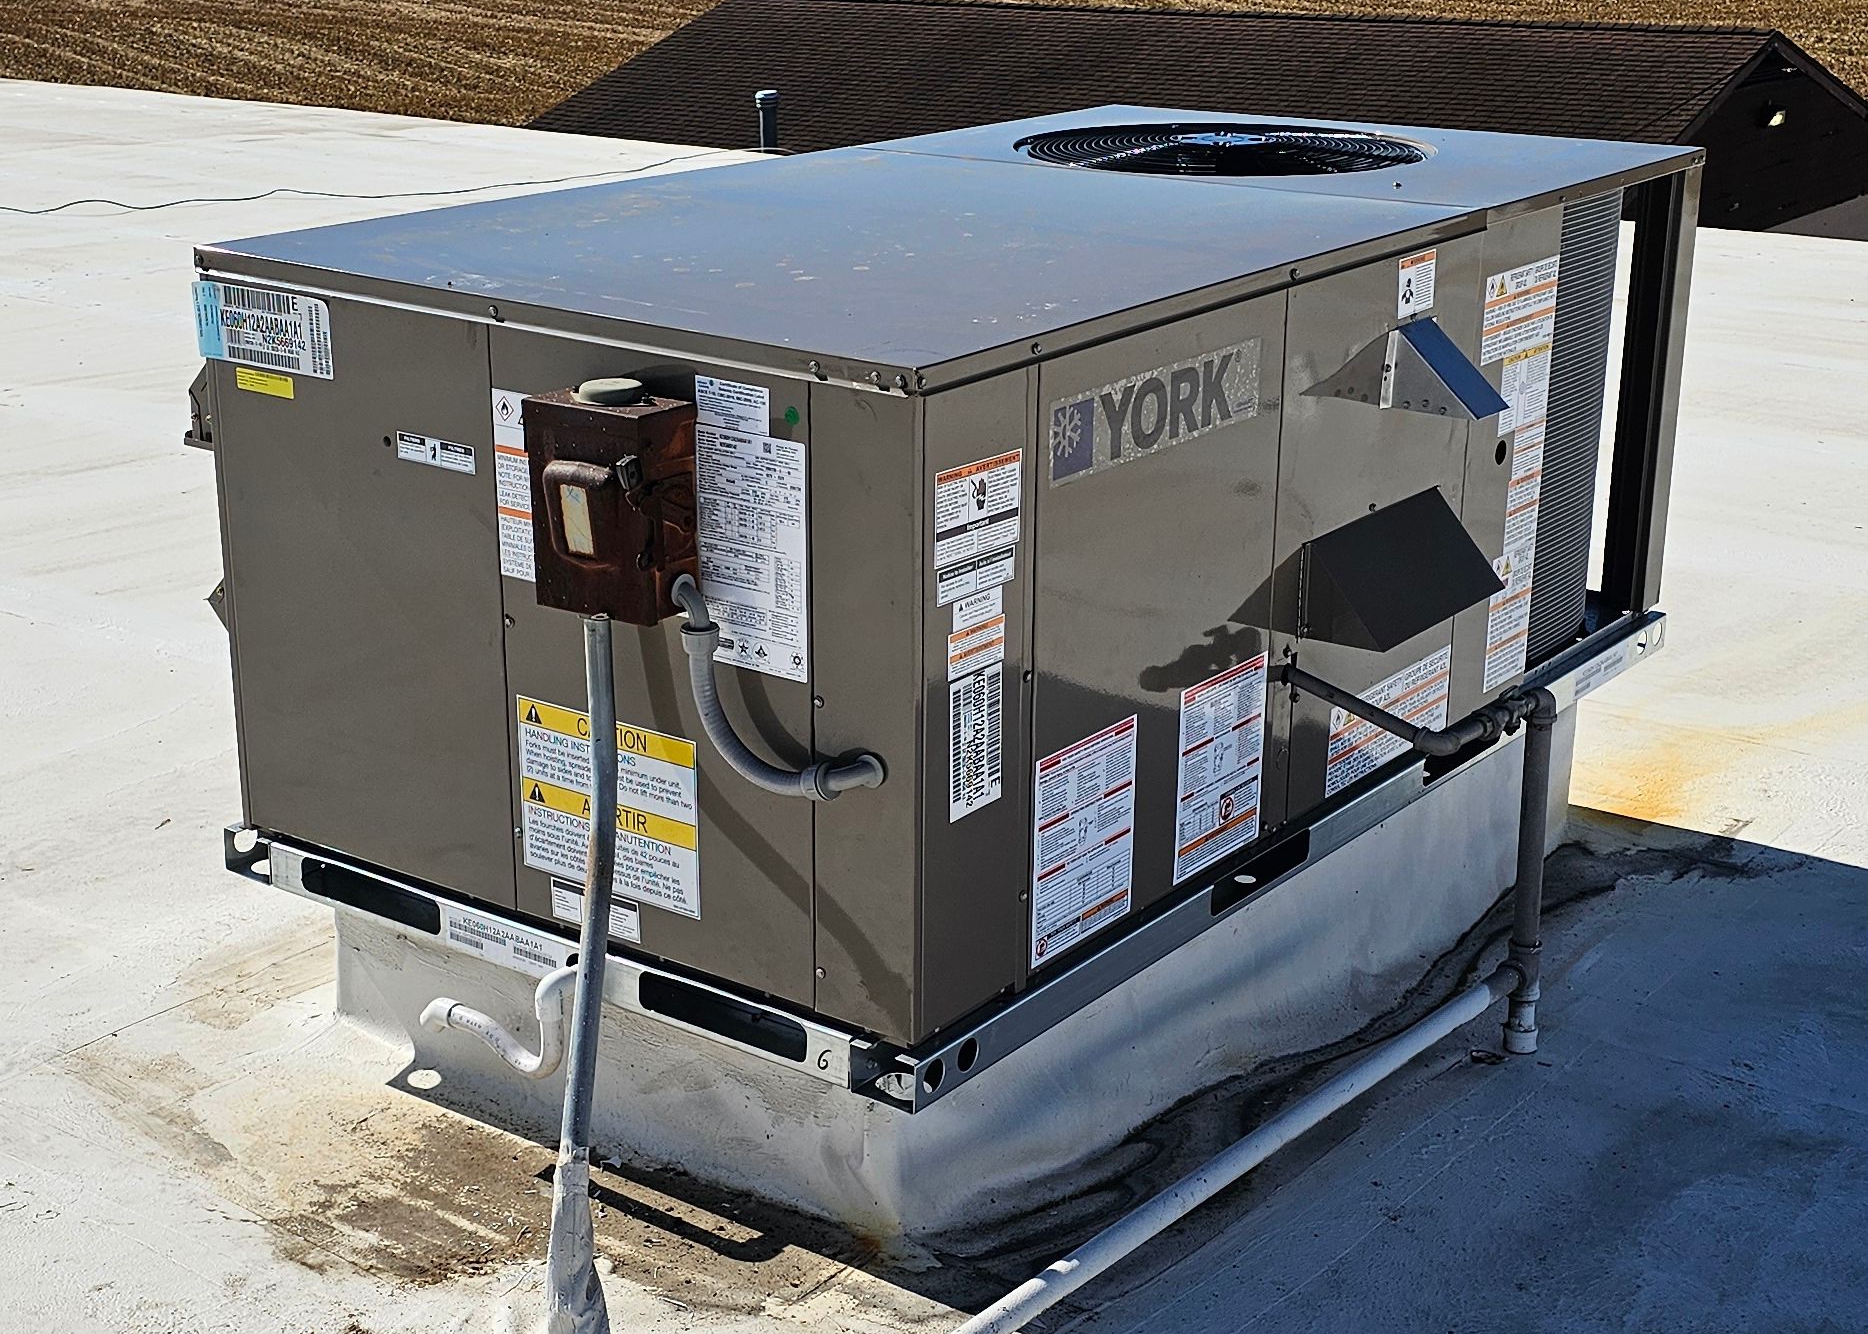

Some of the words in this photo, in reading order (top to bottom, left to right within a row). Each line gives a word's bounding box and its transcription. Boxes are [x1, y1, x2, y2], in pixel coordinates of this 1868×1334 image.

[291, 295, 299, 312] E
[1100, 352, 1234, 461] YORK
[965, 593, 991, 609] WARNING
[524, 727, 569, 748] HANDLING
[972, 669, 986, 801] KE060H12A2AABAA1A1
[991, 776, 1000, 788] E
[528, 805, 590, 832] INSTRUCTIONS
[615, 832, 672, 856] ANUTENTION
[817, 1049, 832, 1070] 6
